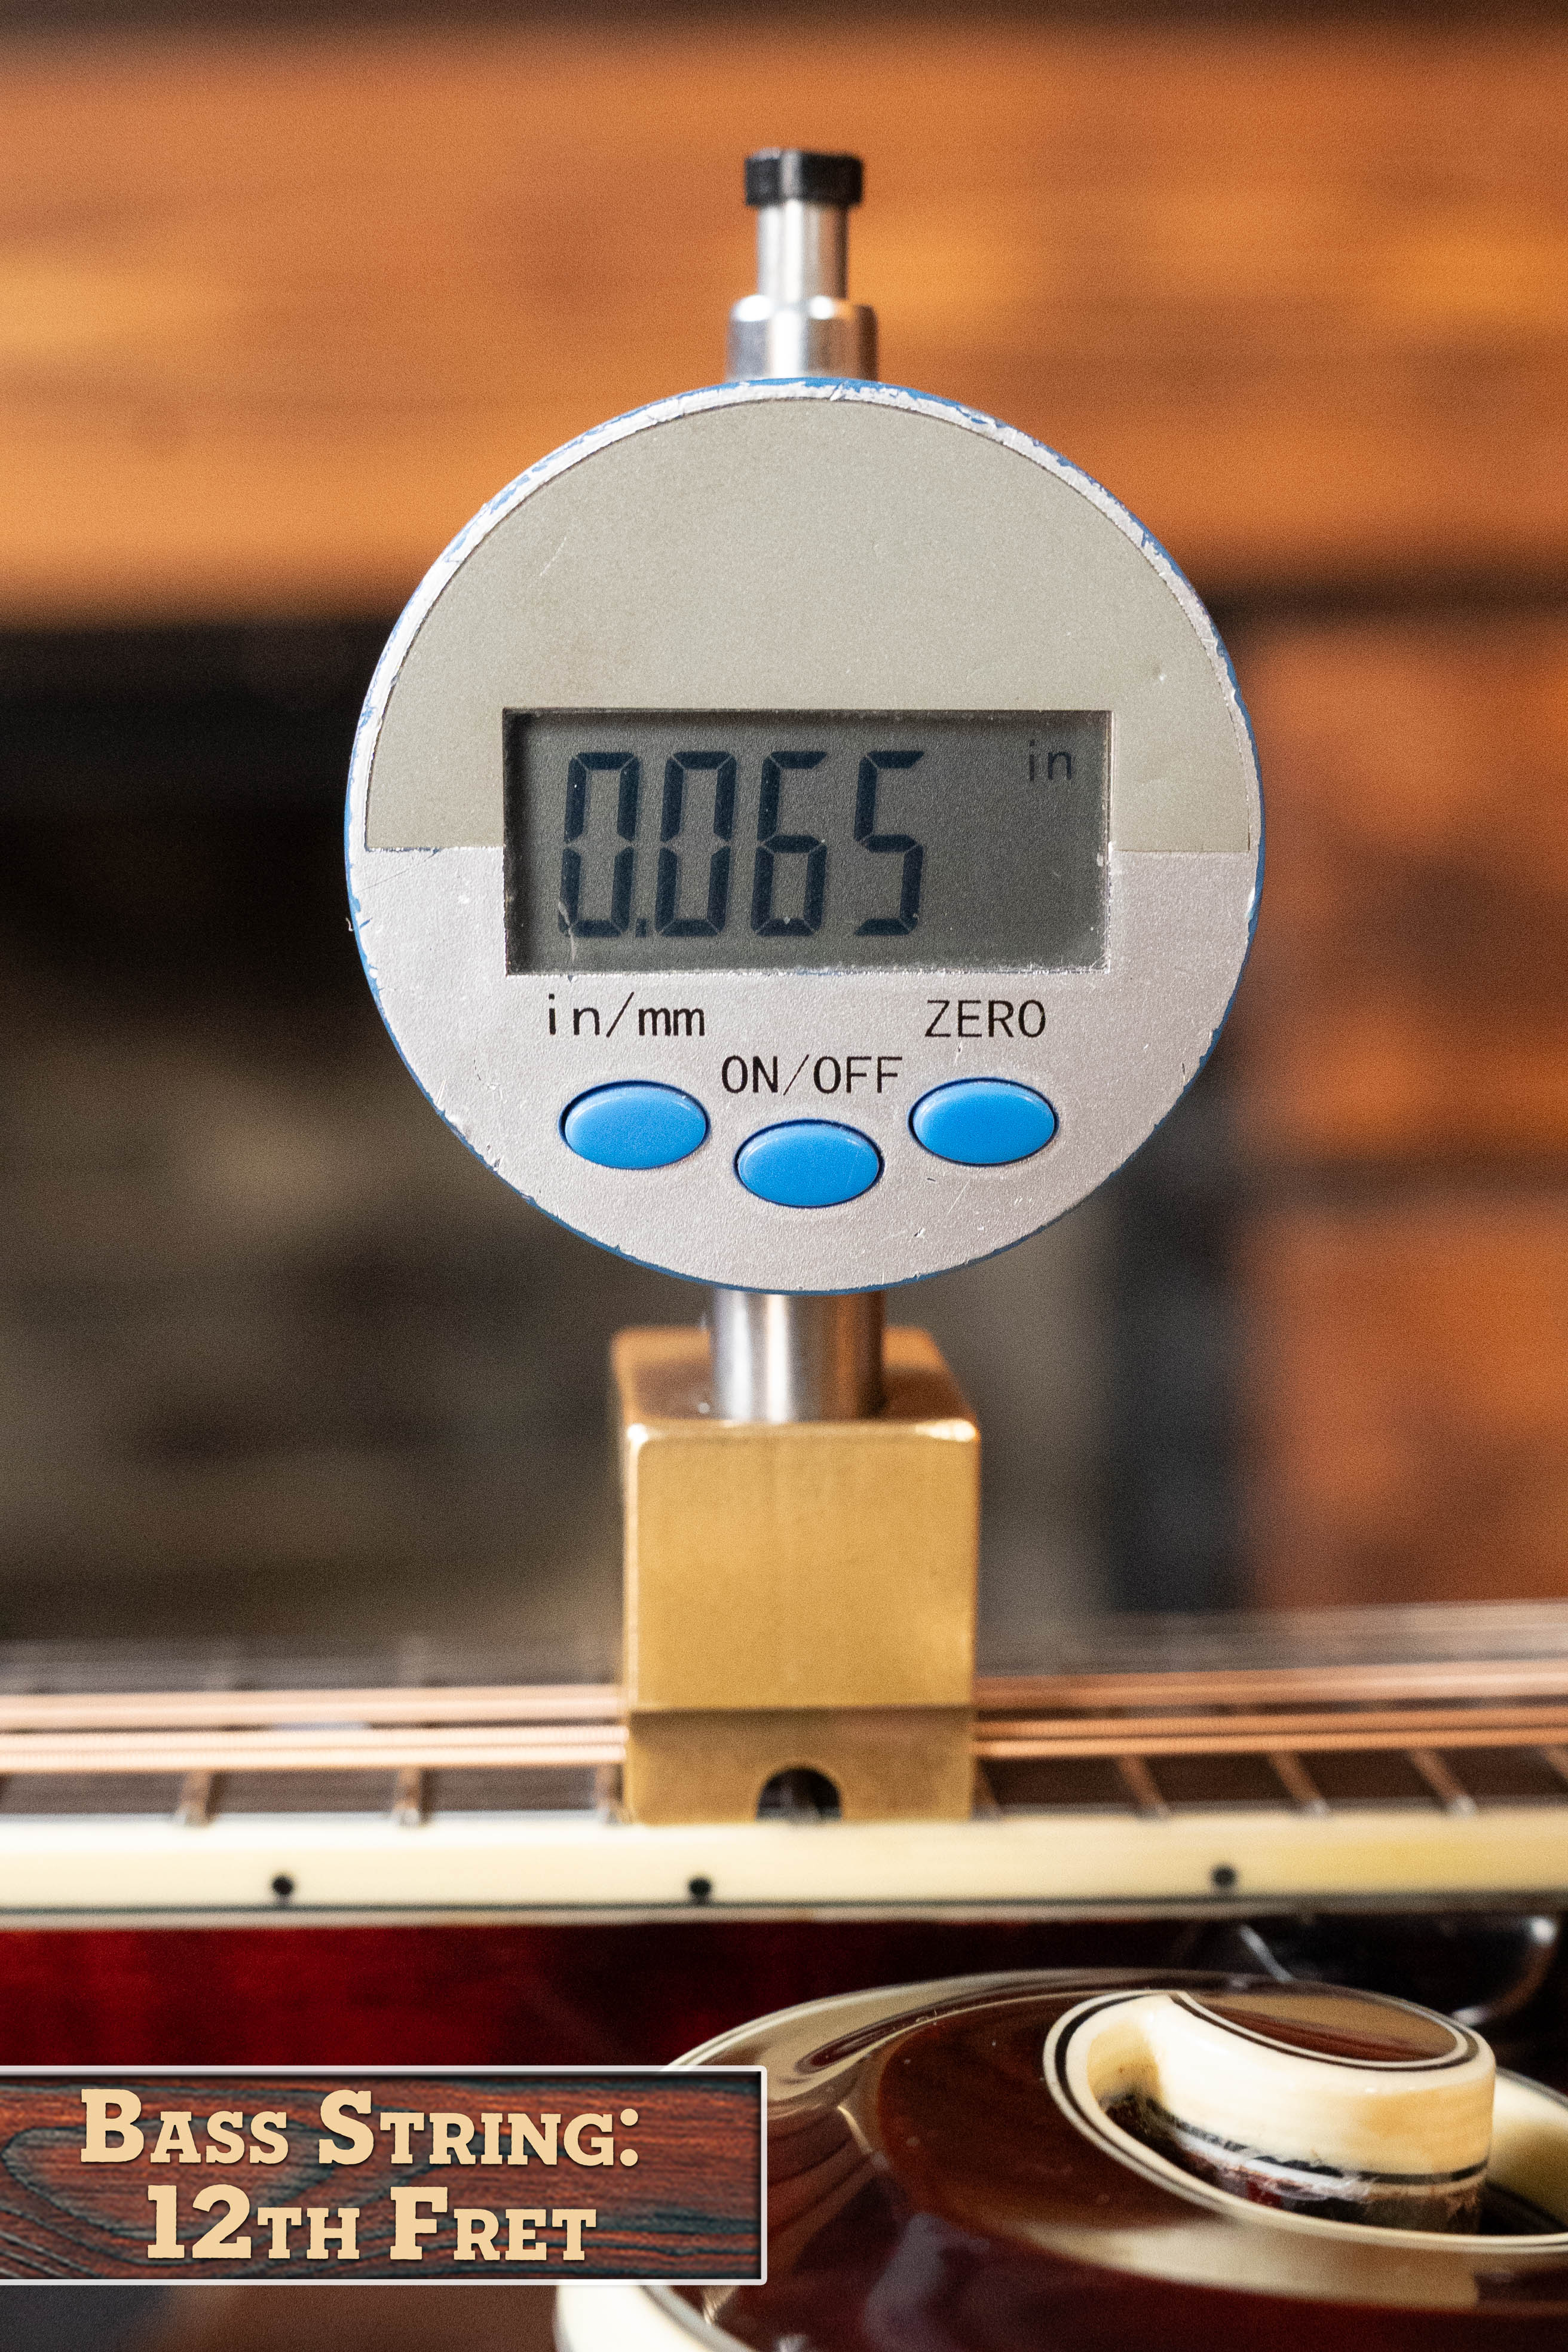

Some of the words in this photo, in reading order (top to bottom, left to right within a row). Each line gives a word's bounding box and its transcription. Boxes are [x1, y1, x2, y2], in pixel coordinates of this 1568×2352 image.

[559, 749, 926, 938] 0.065
[1025, 739, 1074, 783] in
[547, 991, 706, 1038] in/mm
[924, 999, 1046, 1038] ZERO
[721, 1054, 903, 1096] ON/OFF
